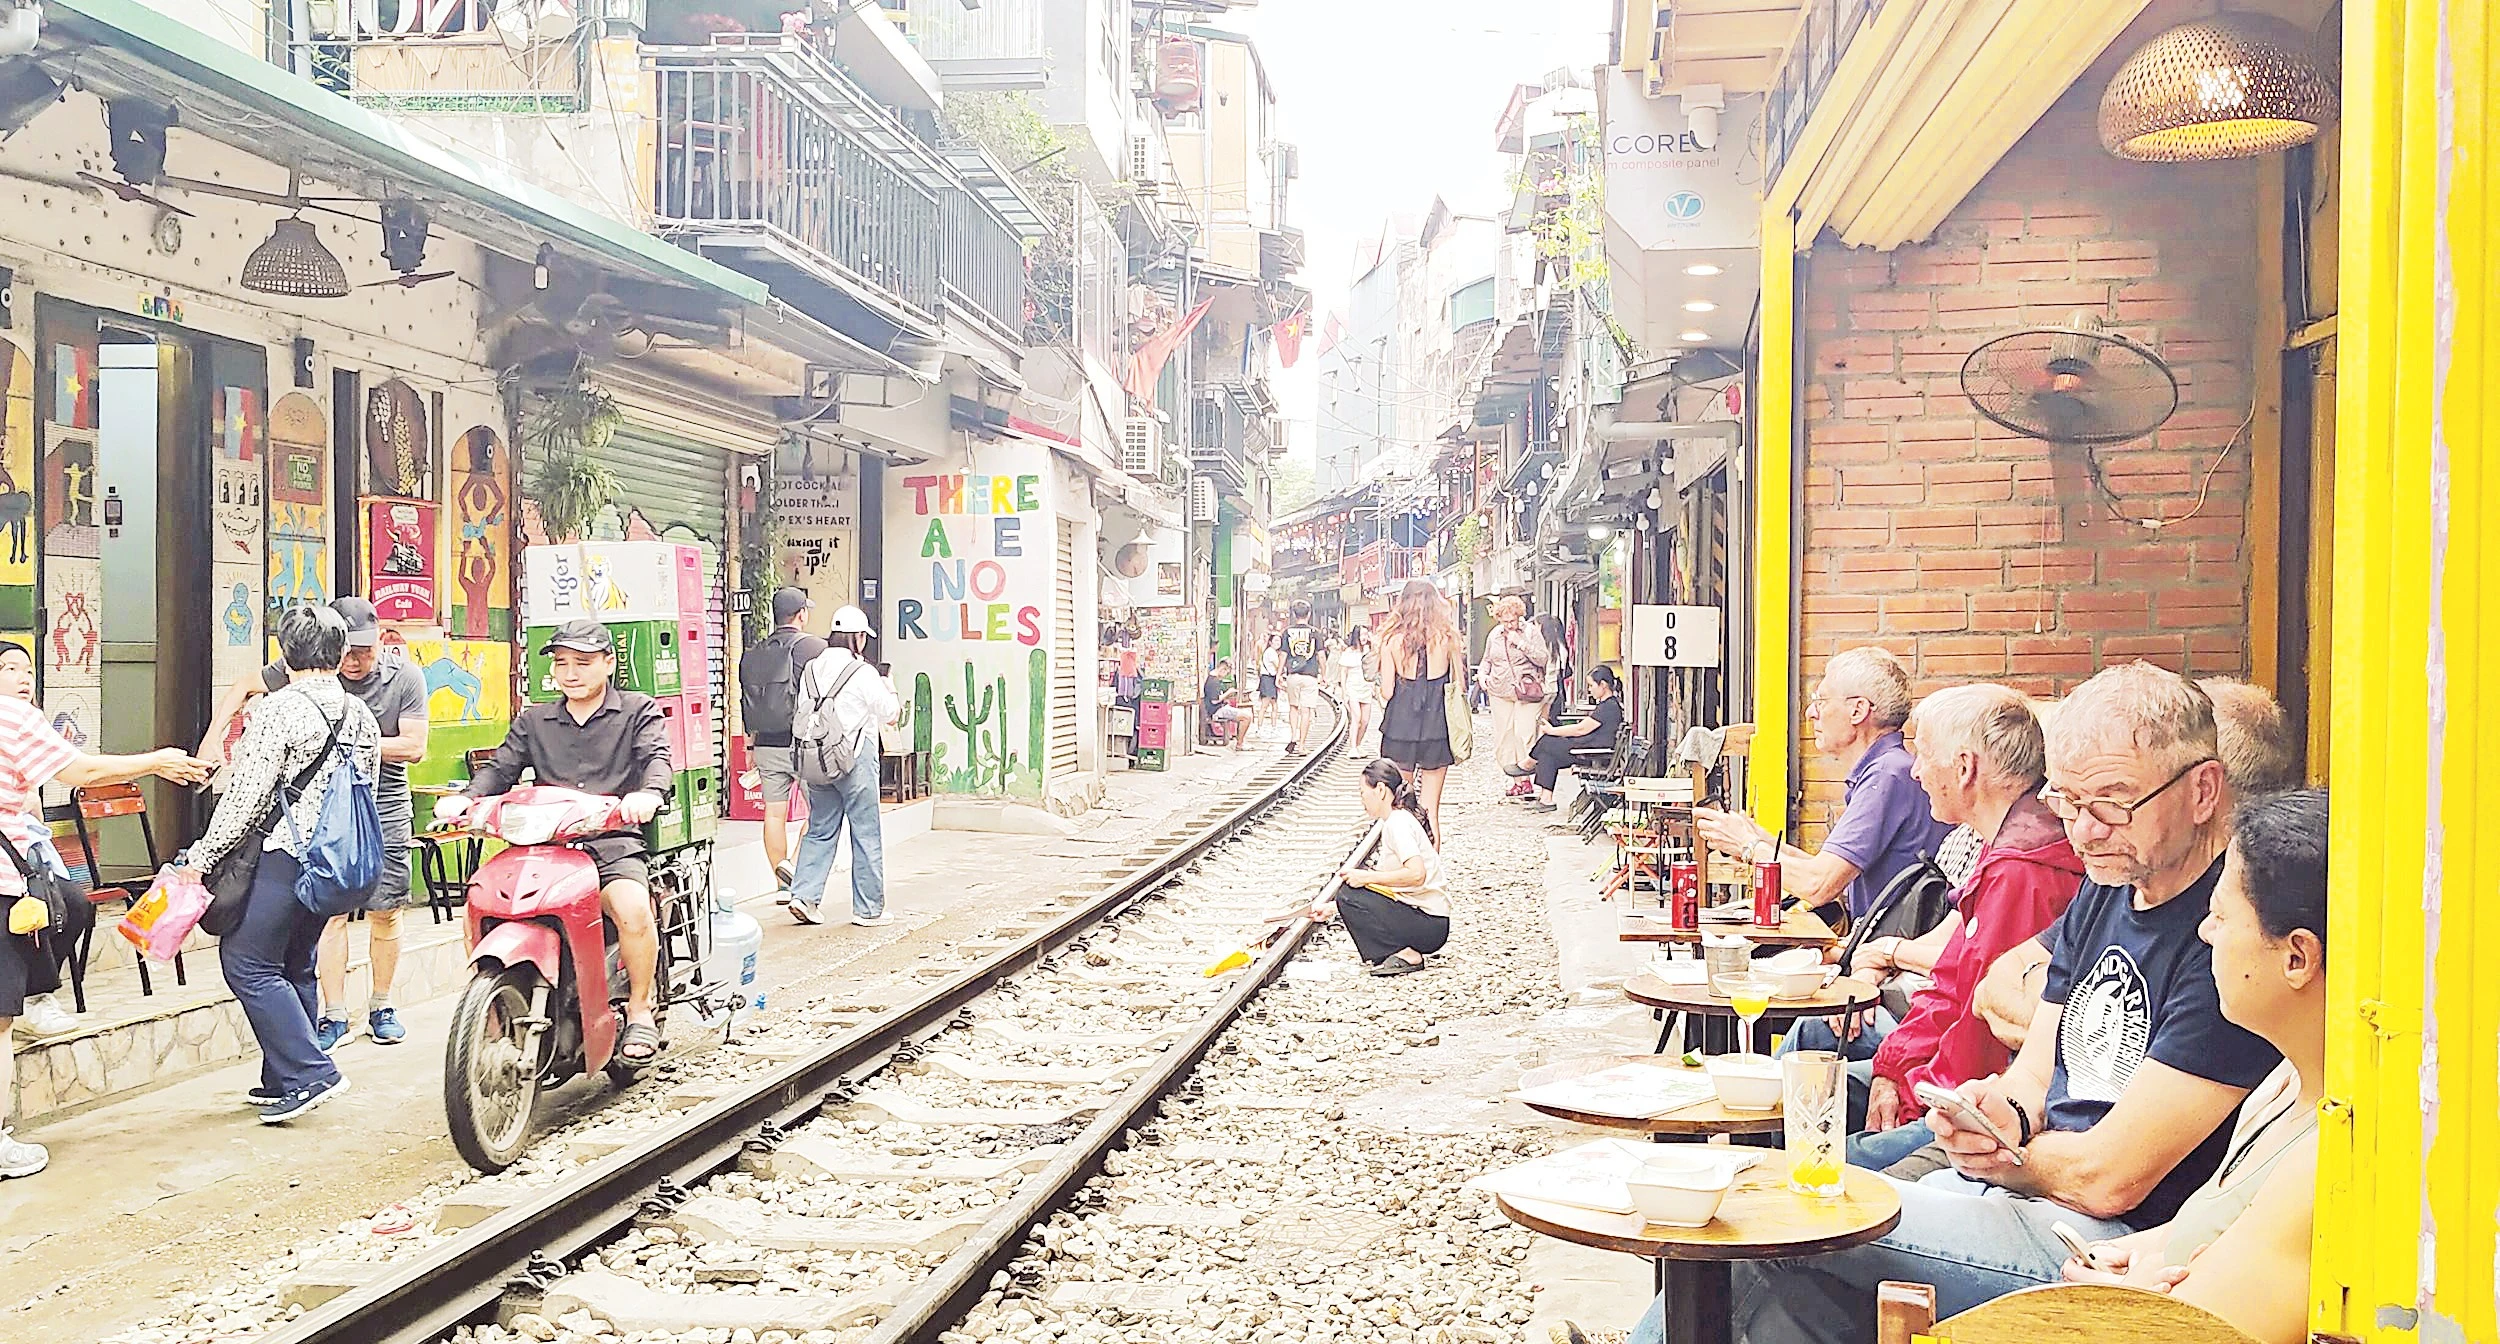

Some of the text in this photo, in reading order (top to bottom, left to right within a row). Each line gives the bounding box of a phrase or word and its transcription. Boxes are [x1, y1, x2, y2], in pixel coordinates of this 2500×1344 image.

[1607, 134, 1718, 154] CORE
[1622, 158, 1683, 172] composite
[1686, 157, 1720, 172] panel
[775, 498, 809, 508] OLDER
[903, 474, 1040, 516] THERE
[788, 515, 813, 525] EX'S
[815, 516, 851, 526] HEART
[920, 517, 1023, 559] AE
[550, 553, 578, 612] Tiger
[932, 559, 1006, 602] NO
[732, 593, 751, 611] 110
[898, 598, 1041, 647] RULES
[1664, 635, 1677, 660] 8
